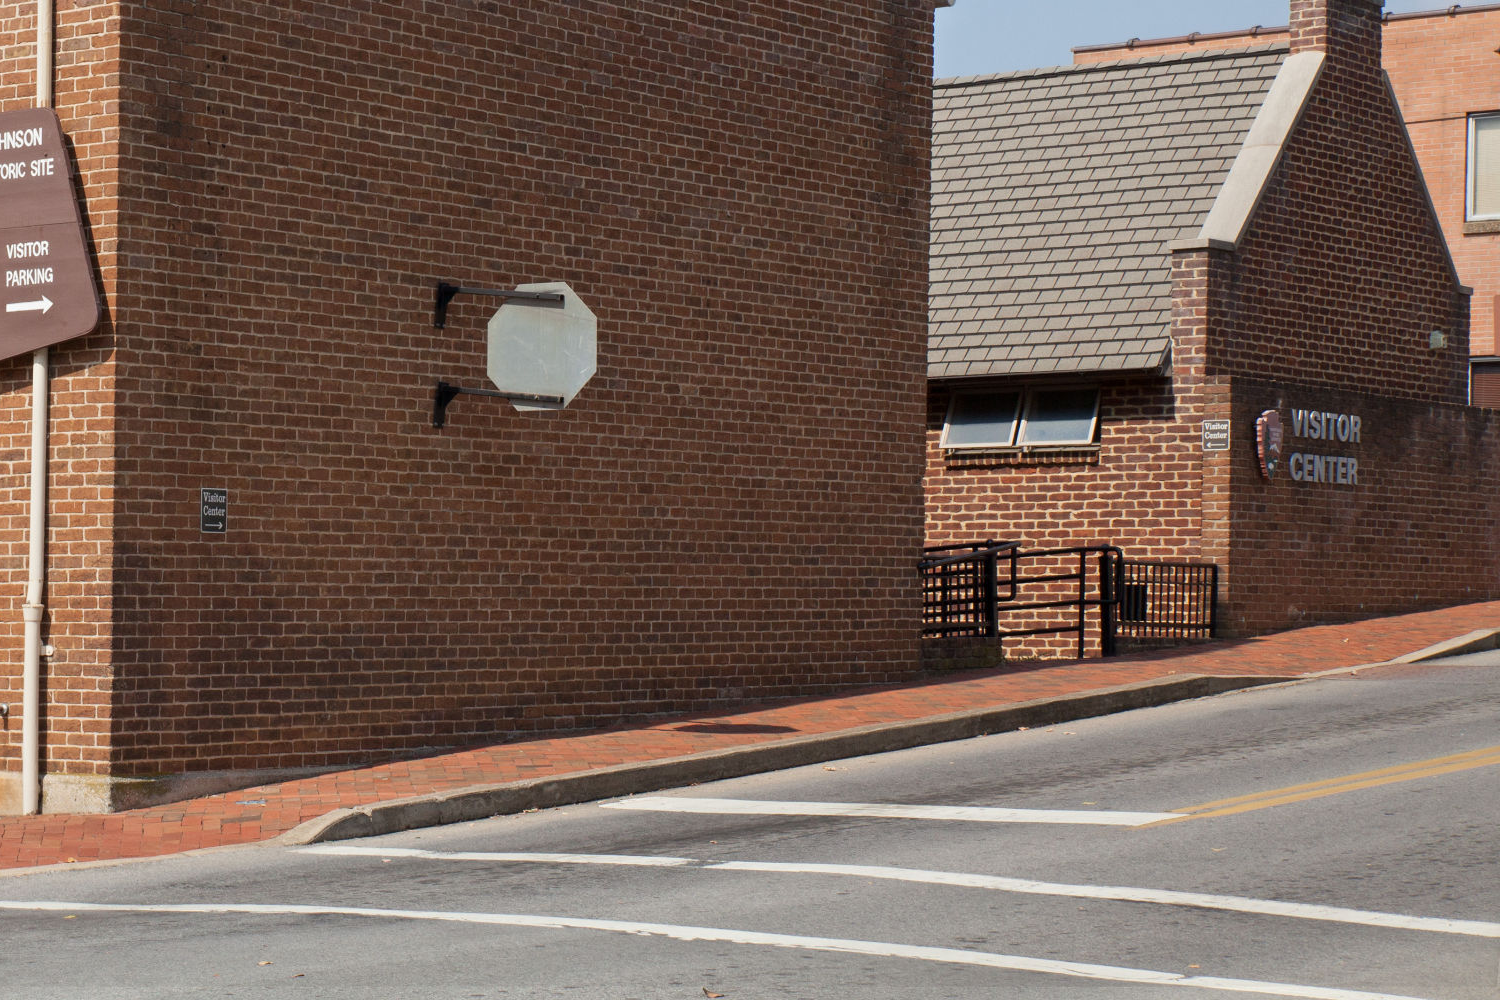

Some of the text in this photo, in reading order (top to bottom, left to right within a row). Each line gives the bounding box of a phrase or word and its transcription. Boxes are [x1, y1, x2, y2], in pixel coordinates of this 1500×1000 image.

[30, 157, 54, 177] SITE
[6, 240, 49, 259] VISITOR
[6, 267, 54, 287] PARKING
[1204, 422, 1228, 431] Visitor
[1291, 408, 1362, 443] VISITOR
[1204, 431, 1228, 440] Center
[1289, 452, 1359, 486] CENTER
[203, 491, 226, 503] Visitor
[203, 505, 226, 517] Center
